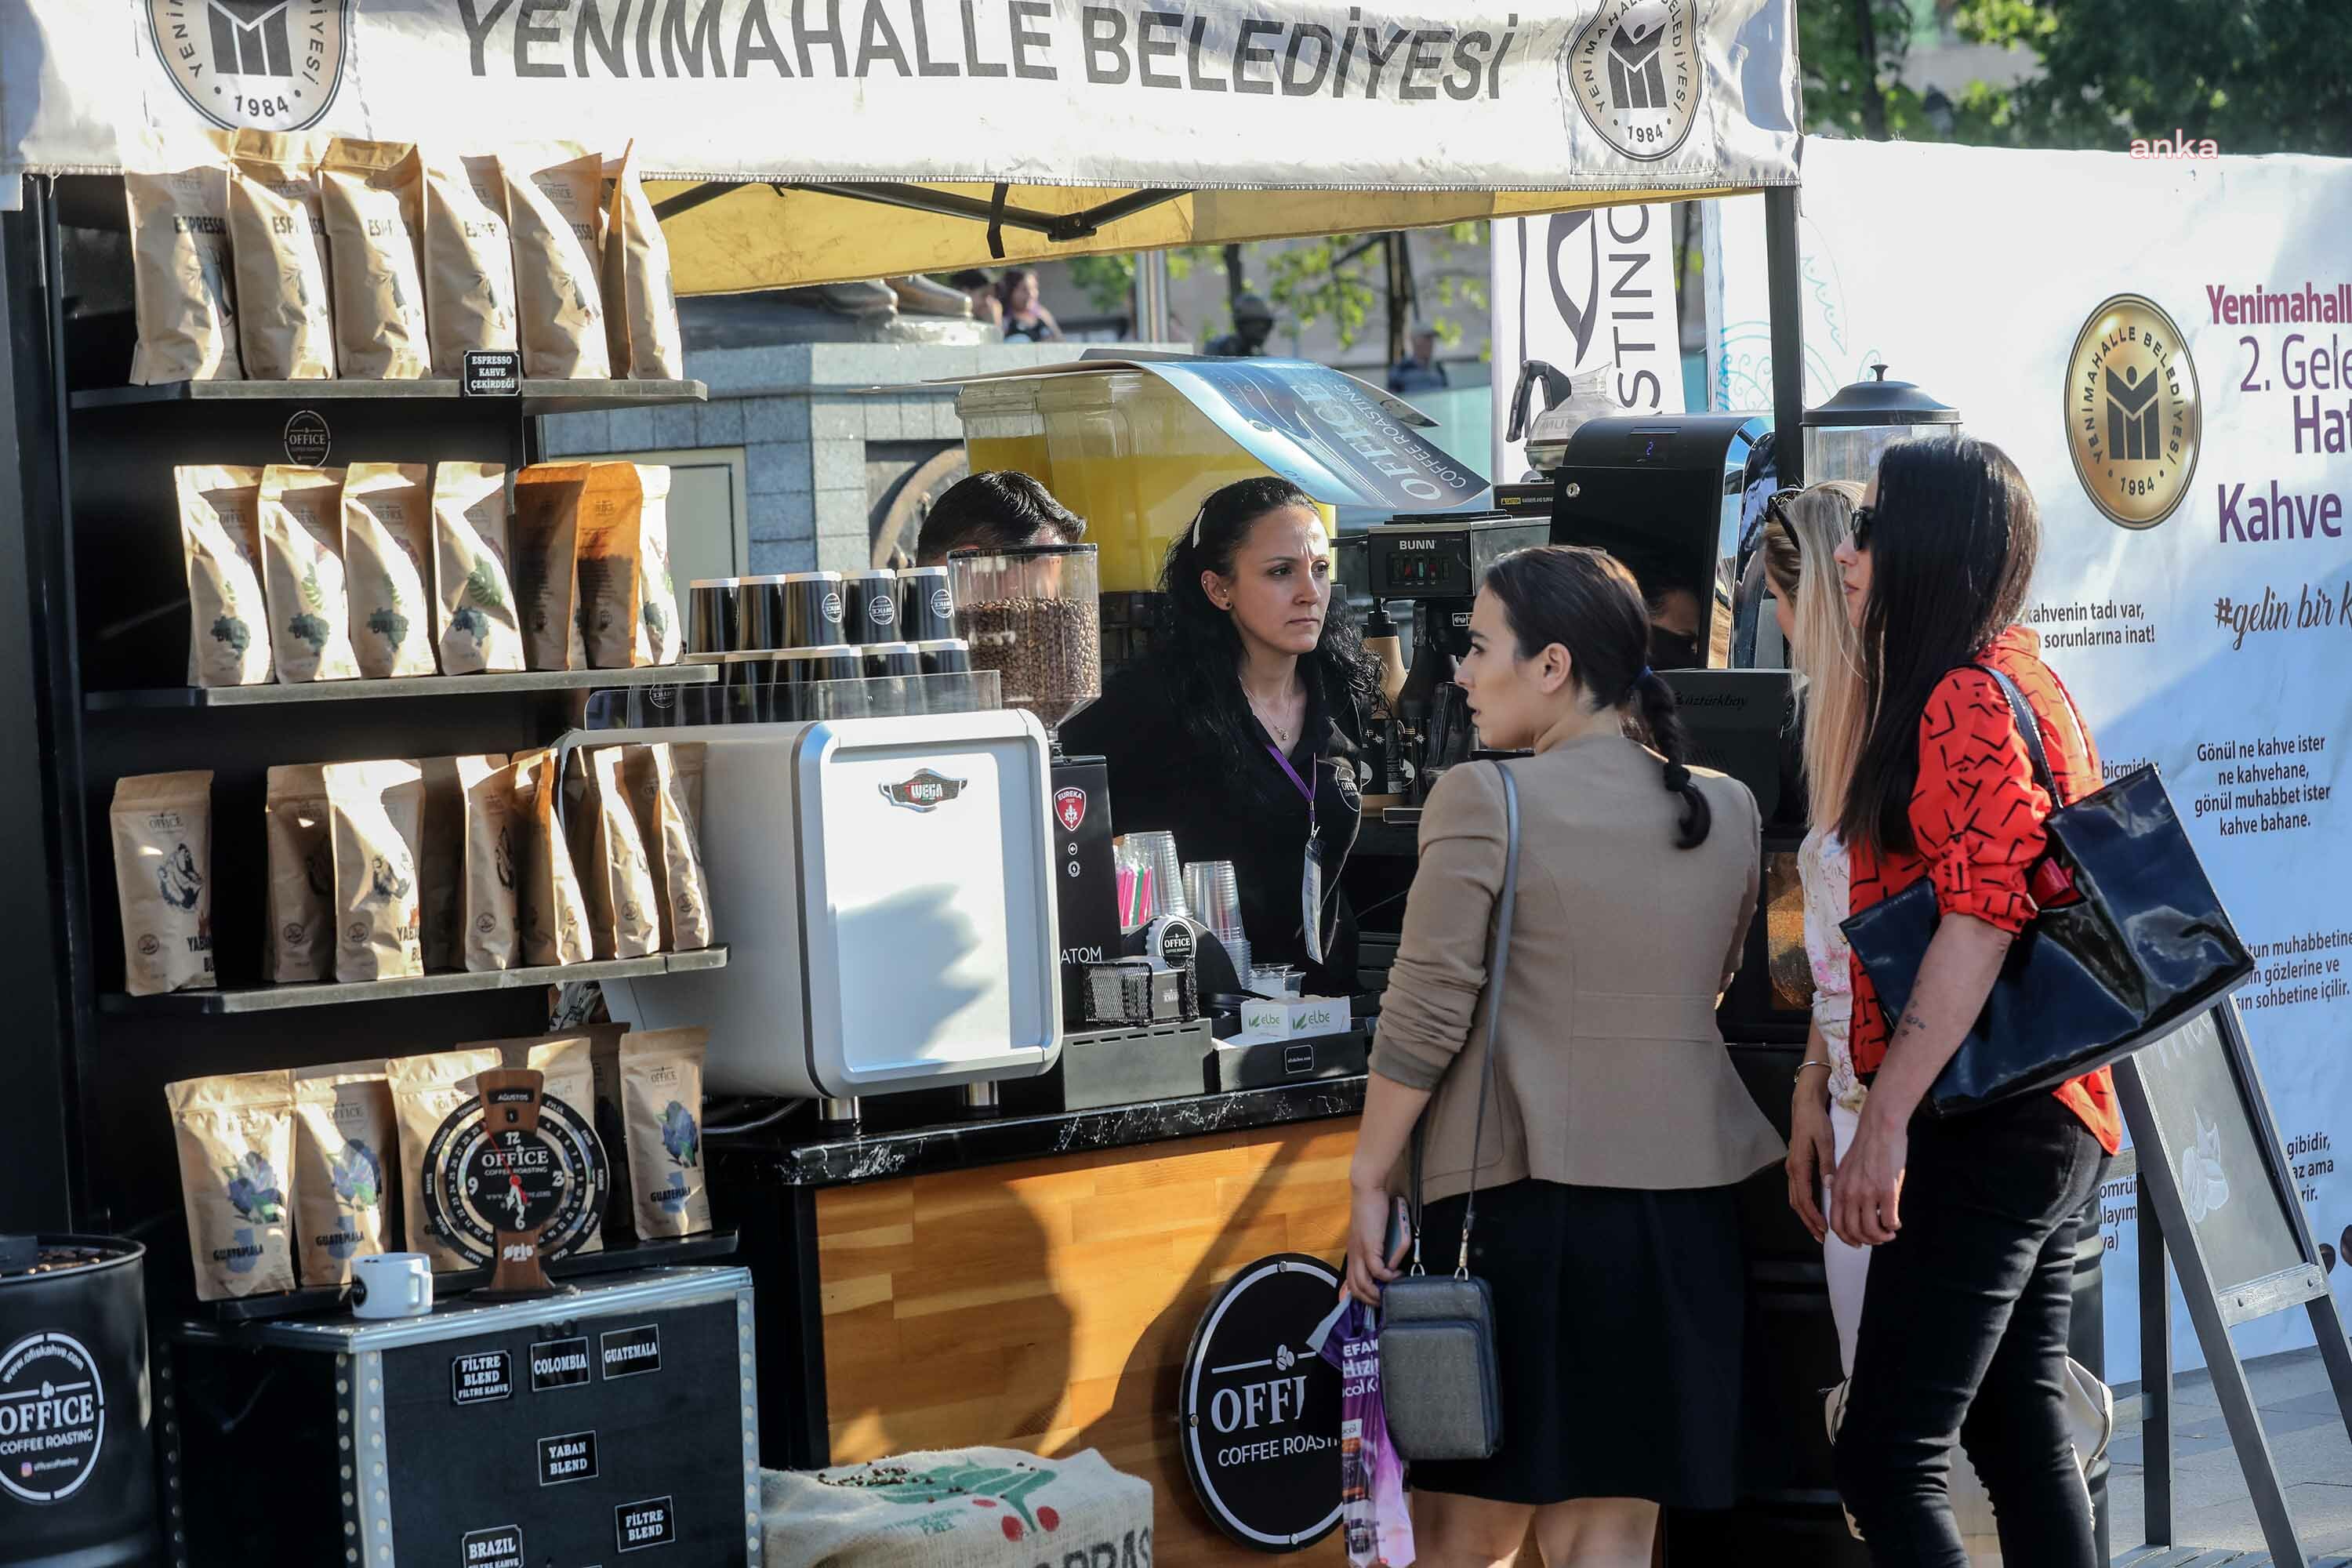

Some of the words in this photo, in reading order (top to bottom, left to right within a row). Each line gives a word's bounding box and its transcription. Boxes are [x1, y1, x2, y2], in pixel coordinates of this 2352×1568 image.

[1081, 5, 1519, 100] BELEDİYESİ
[234, 95, 289, 118] 1984
[1627, 124, 1664, 143] 1984
[471, 356, 512, 365] ESPRESSO
[2238, 335, 2271, 392] 2.
[478, 368, 506, 376] KAHVE
[289, 434, 327, 445] OFFICE
[1404, 441, 1467, 489] COFFEE
[2120, 476, 2155, 496] 1984
[2217, 479, 2343, 543] Kahve
[1399, 539, 1436, 550] BUNN
[2090, 599, 2118, 621] tadı
[2120, 602, 2145, 621] var,
[2215, 585, 2292, 652] #gelin
[2297, 583, 2336, 628] bir
[2044, 626, 2122, 649] sorunlarına
[2125, 624, 2156, 644] inat!
[2197, 740, 2236, 761] Gönül
[2238, 744, 2255, 758] ne
[2258, 737, 2296, 757] kahve
[2298, 735, 2326, 753] ister
[2218, 771, 2234, 786] ne
[2237, 763, 2310, 785] kahvehane,
[910, 782, 943, 800] WEGA
[1058, 790, 1083, 800] EUREKA
[2194, 792, 2233, 818] gönül
[2235, 787, 2301, 811] muhabbet
[2303, 784, 2331, 803] ister
[2220, 817, 2258, 837] kahve
[2261, 812, 2311, 832] bahane.
[1163, 937, 1191, 949] OFFICE
[1060, 945, 1103, 964] ATOM
[2264, 959, 2323, 987] gözlerine
[2325, 958, 2340, 973] ve
[2256, 984, 2318, 1009] sohbetine
[2321, 978, 2350, 1004] içilir.
[1261, 1013, 1280, 1025] elbe
[1308, 1009, 1330, 1024] elbe
[505, 1131, 521, 1145] 12
[2287, 1133, 2332, 1162] gibidir,
[481, 1150, 549, 1167] OFFICE
[2307, 1158, 2335, 1176] ama
[467, 1176, 479, 1196] 9
[551, 1171, 564, 1187] 3
[604, 1341, 658, 1364] GUATEMALA
[533, 1352, 587, 1375] COLOMBIA
[464, 1372, 500, 1387] BLEND
[0, 1393, 95, 1436] OFFICE
[1, 1436, 45, 1455] COFFEE
[45, 1428, 94, 1449] ROASTING
[549, 1441, 586, 1459] YABAN
[1218, 1439, 1279, 1467] COFFEE
[550, 1457, 588, 1475] BLEND
[628, 1523, 664, 1542] BLEND
[468, 1536, 517, 1559] BRAZIL
